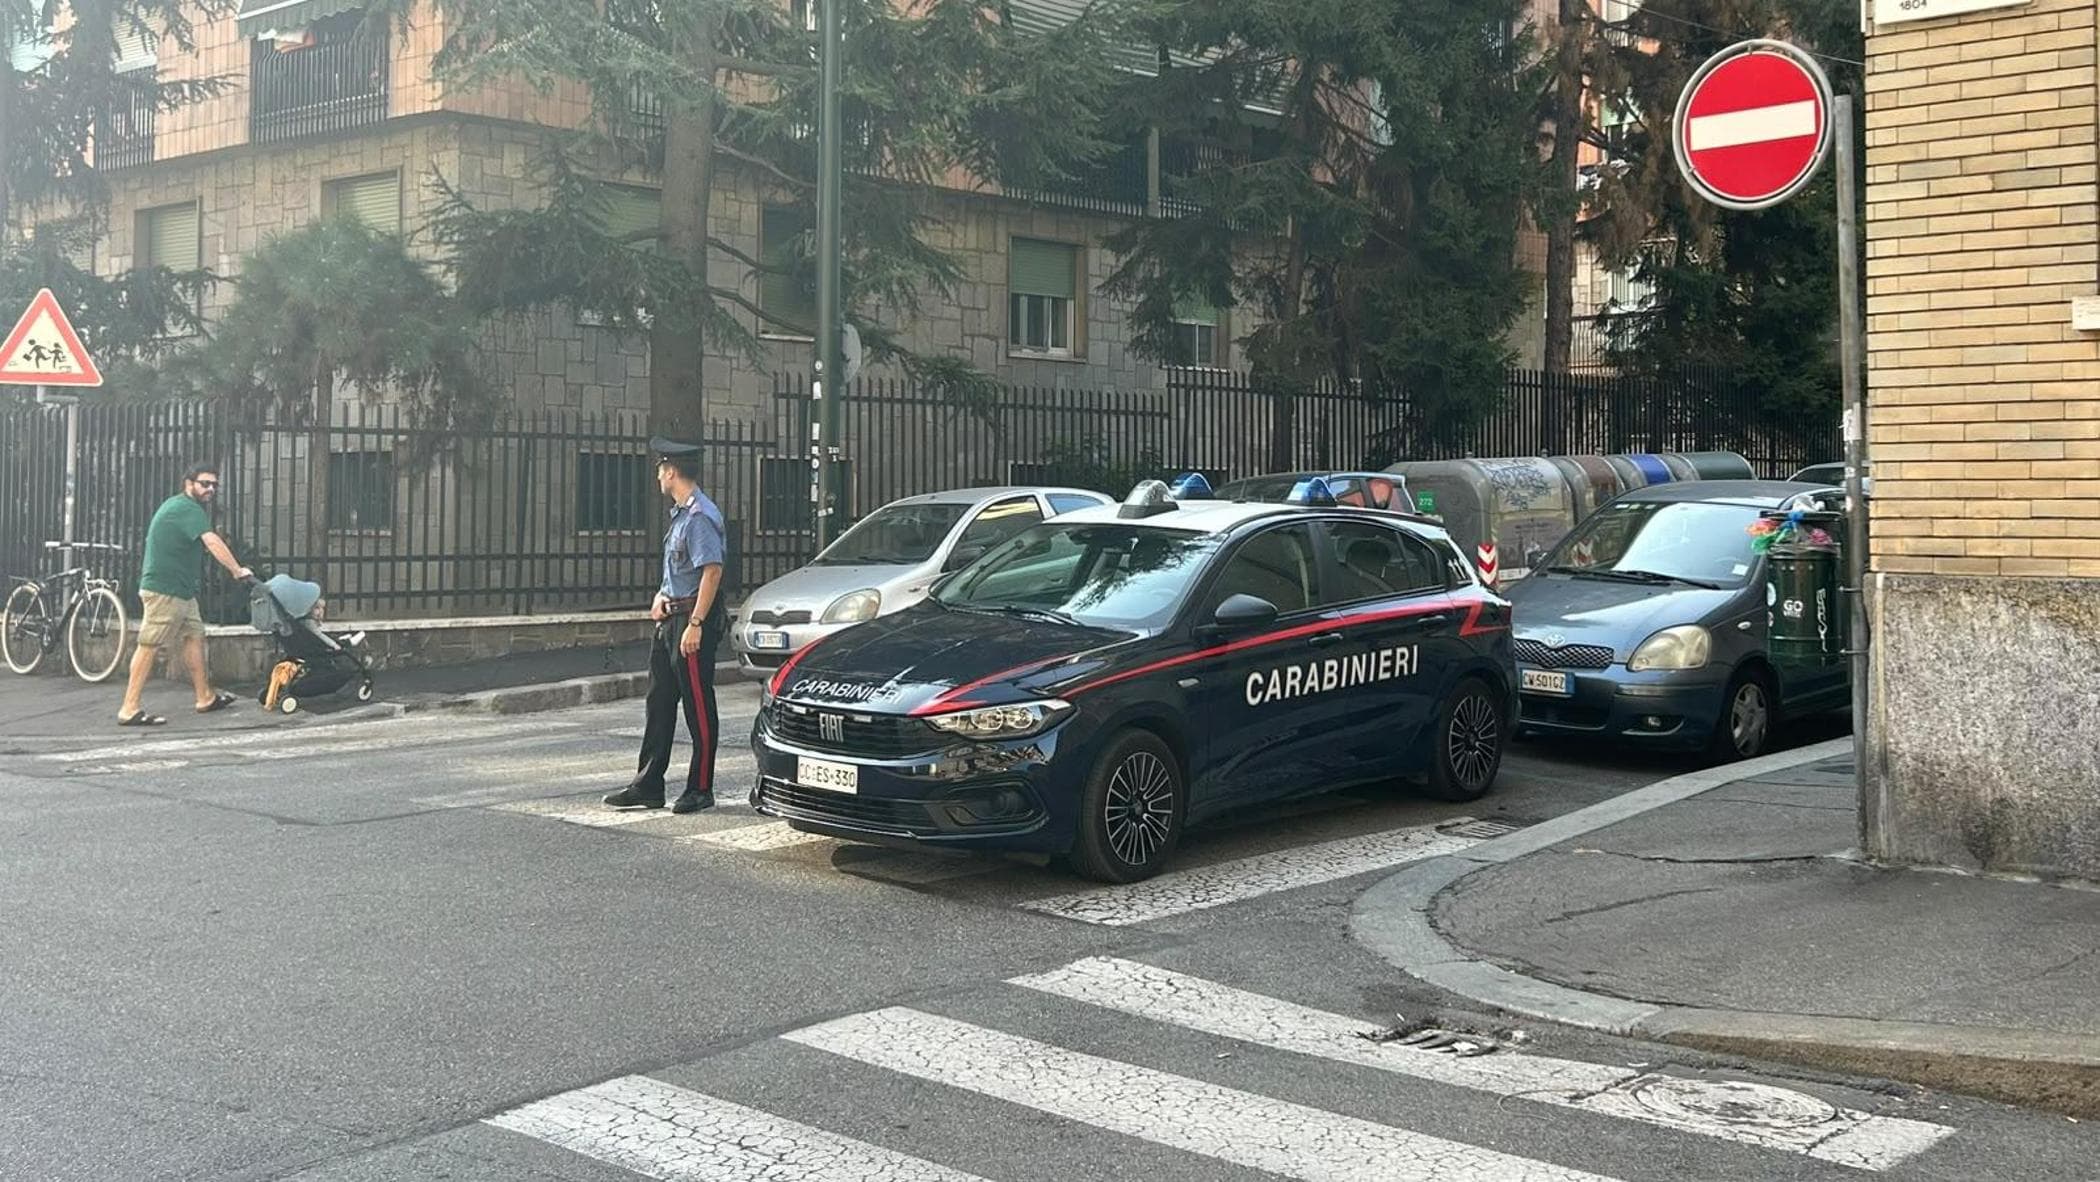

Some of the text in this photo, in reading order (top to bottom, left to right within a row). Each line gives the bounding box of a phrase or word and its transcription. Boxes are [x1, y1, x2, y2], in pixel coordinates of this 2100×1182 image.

[1783, 599, 1804, 612] GO
[1246, 644, 1418, 706] CARABINIERI
[792, 679, 903, 704] CARABINIERI
[819, 712, 845, 743] FIAT
